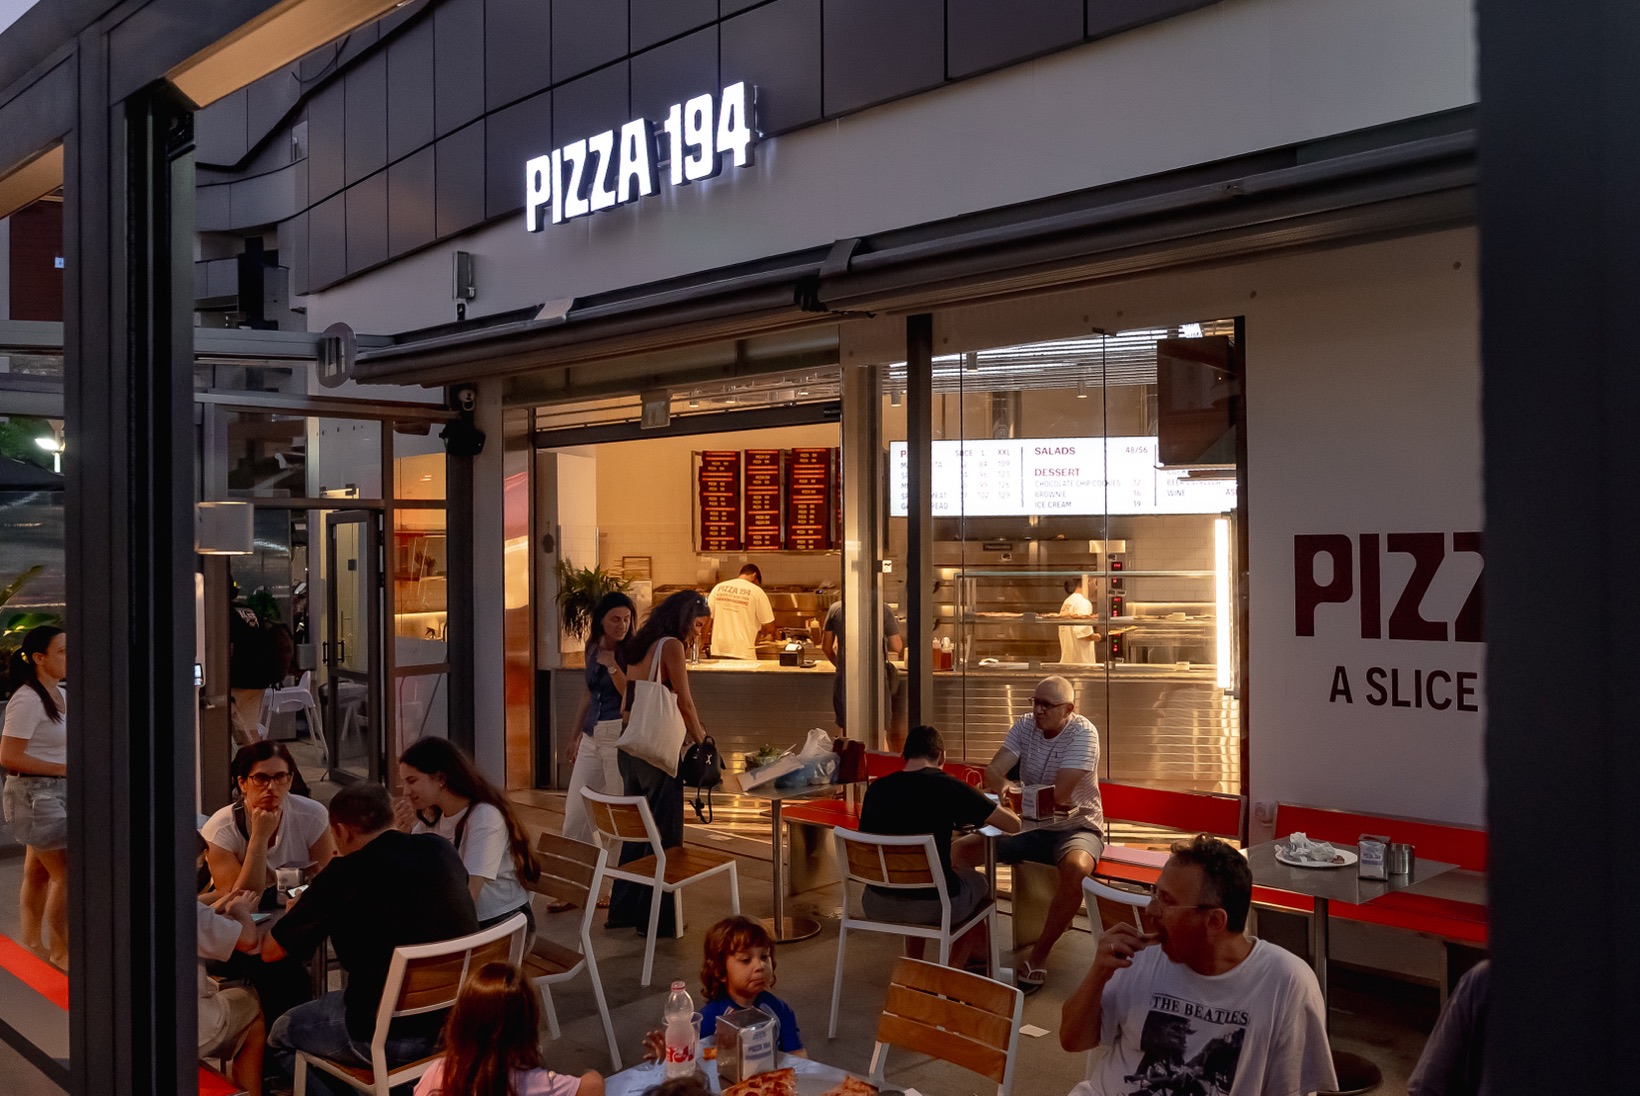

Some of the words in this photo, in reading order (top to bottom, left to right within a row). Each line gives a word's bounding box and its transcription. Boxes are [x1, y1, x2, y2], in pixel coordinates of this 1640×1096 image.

[526, 117, 653, 233] PIZZA
[664, 81, 751, 186] 194
[997, 448, 1011, 456] XXL
[1034, 446, 1076, 455] SALADS
[1034, 468, 1080, 477] DESSERT
[1034, 480, 1074, 488] CHOCOLATE
[1075, 480, 1092, 488] CHIP
[1034, 501, 1046, 509] ICE
[1047, 501, 1073, 509] CREAM
[1329, 665, 1353, 704] A
[1365, 666, 1479, 713] SLICE
[1152, 995, 1181, 1013] THE
